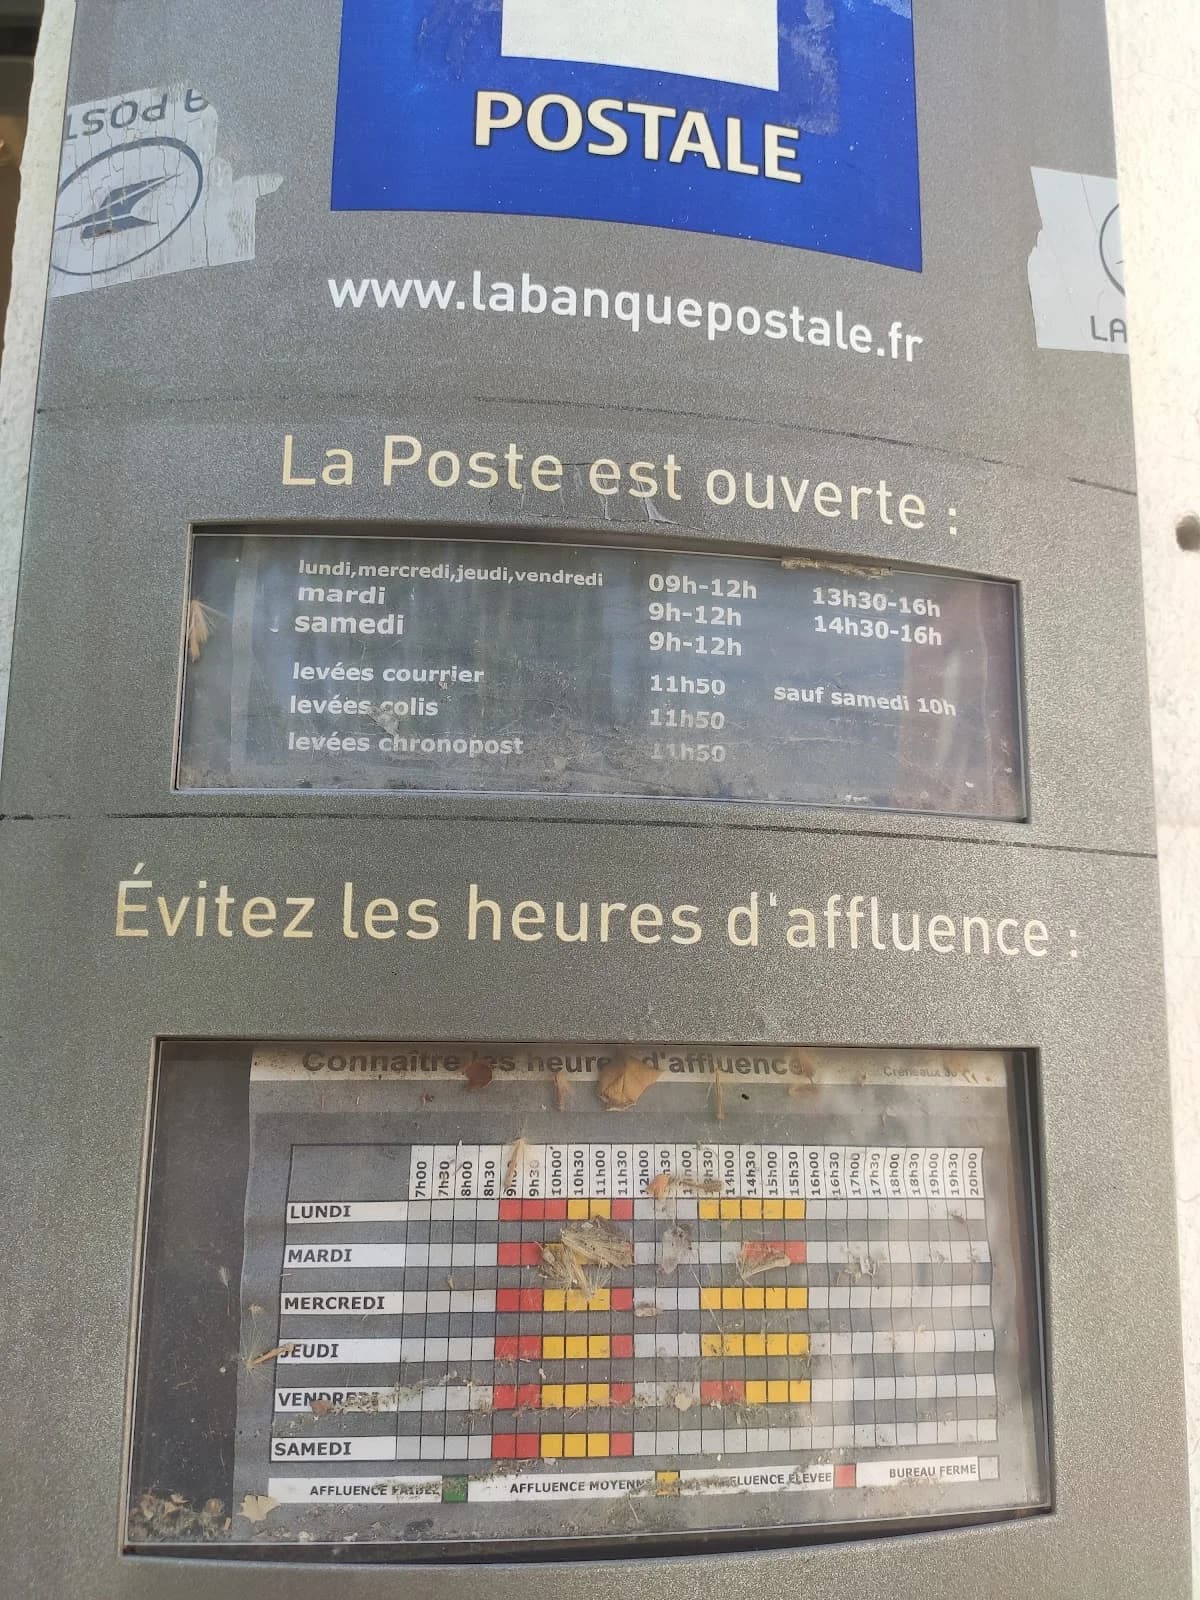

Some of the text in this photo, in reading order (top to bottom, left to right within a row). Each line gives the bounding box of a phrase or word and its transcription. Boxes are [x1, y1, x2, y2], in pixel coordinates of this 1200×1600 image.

[474, 90, 803, 184] POSTALE
[327, 270, 924, 363] www.labanquepostale.fr
[1090, 314, 1127, 343] LA
[281, 433, 958, 536] La Poste est ouverte :
[299, 560, 604, 587] lundi,mercredi,jeudi,vendredi
[648, 573, 757, 600] 09h-12h
[298, 586, 386, 605] mardi
[812, 587, 941, 618] 13h30-16h
[294, 614, 405, 635] samedi
[648, 602, 742, 626] 9h-12h
[813, 616, 943, 646] 14h30-16h
[648, 631, 742, 656] 9h-12h
[292, 662, 485, 683] levées courrier
[650, 674, 726, 696] 11h50
[290, 695, 439, 717] levées colis
[650, 708, 726, 730] 11h50
[773, 685, 957, 717] sauf samedi 10h
[287, 732, 524, 757] levées chronopost
[114, 862, 316, 939] Évitez
[342, 881, 439, 940] les
[467, 883, 702, 945] heures
[727, 891, 1049, 957] d'affluence
[527, 1051, 614, 1073] heure
[415, 1161, 427, 1197] 7h00
[438, 1161, 450, 1197] 7h30
[461, 1161, 473, 1197] 8h00
[483, 1160, 495, 1197] 8h30
[552, 1150, 562, 1197] 10h00
[574, 1150, 584, 1196] 10h30
[595, 1150, 606, 1196] 11h00
[617, 1150, 627, 1196] 11h30
[725, 1150, 734, 1196] 14h00
[746, 1150, 756, 1196] 14h30
[767, 1150, 778, 1196] 15h00
[789, 1150, 799, 1196] 15h30
[810, 1151, 821, 1196] 16h00
[830, 1151, 840, 1196] 16h30
[851, 1152, 861, 1196] 17h00
[871, 1152, 881, 1196] 17h30
[890, 1152, 900, 1196] 18h00
[910, 1152, 920, 1196] 18h30
[929, 1152, 940, 1196] 19h00
[949, 1152, 959, 1196] 19h30
[969, 1152, 979, 1196] 20h00
[290, 1205, 352, 1219] LUNDI
[288, 1248, 352, 1263] MARDI
[284, 1296, 385, 1310] MERCREDI
[274, 1441, 352, 1456] SAMEDI
[510, 1481, 585, 1494] AFFLUENCE
[889, 1464, 977, 1479] BUREAU FERME
[310, 1485, 388, 1496] AFFLUENCE
